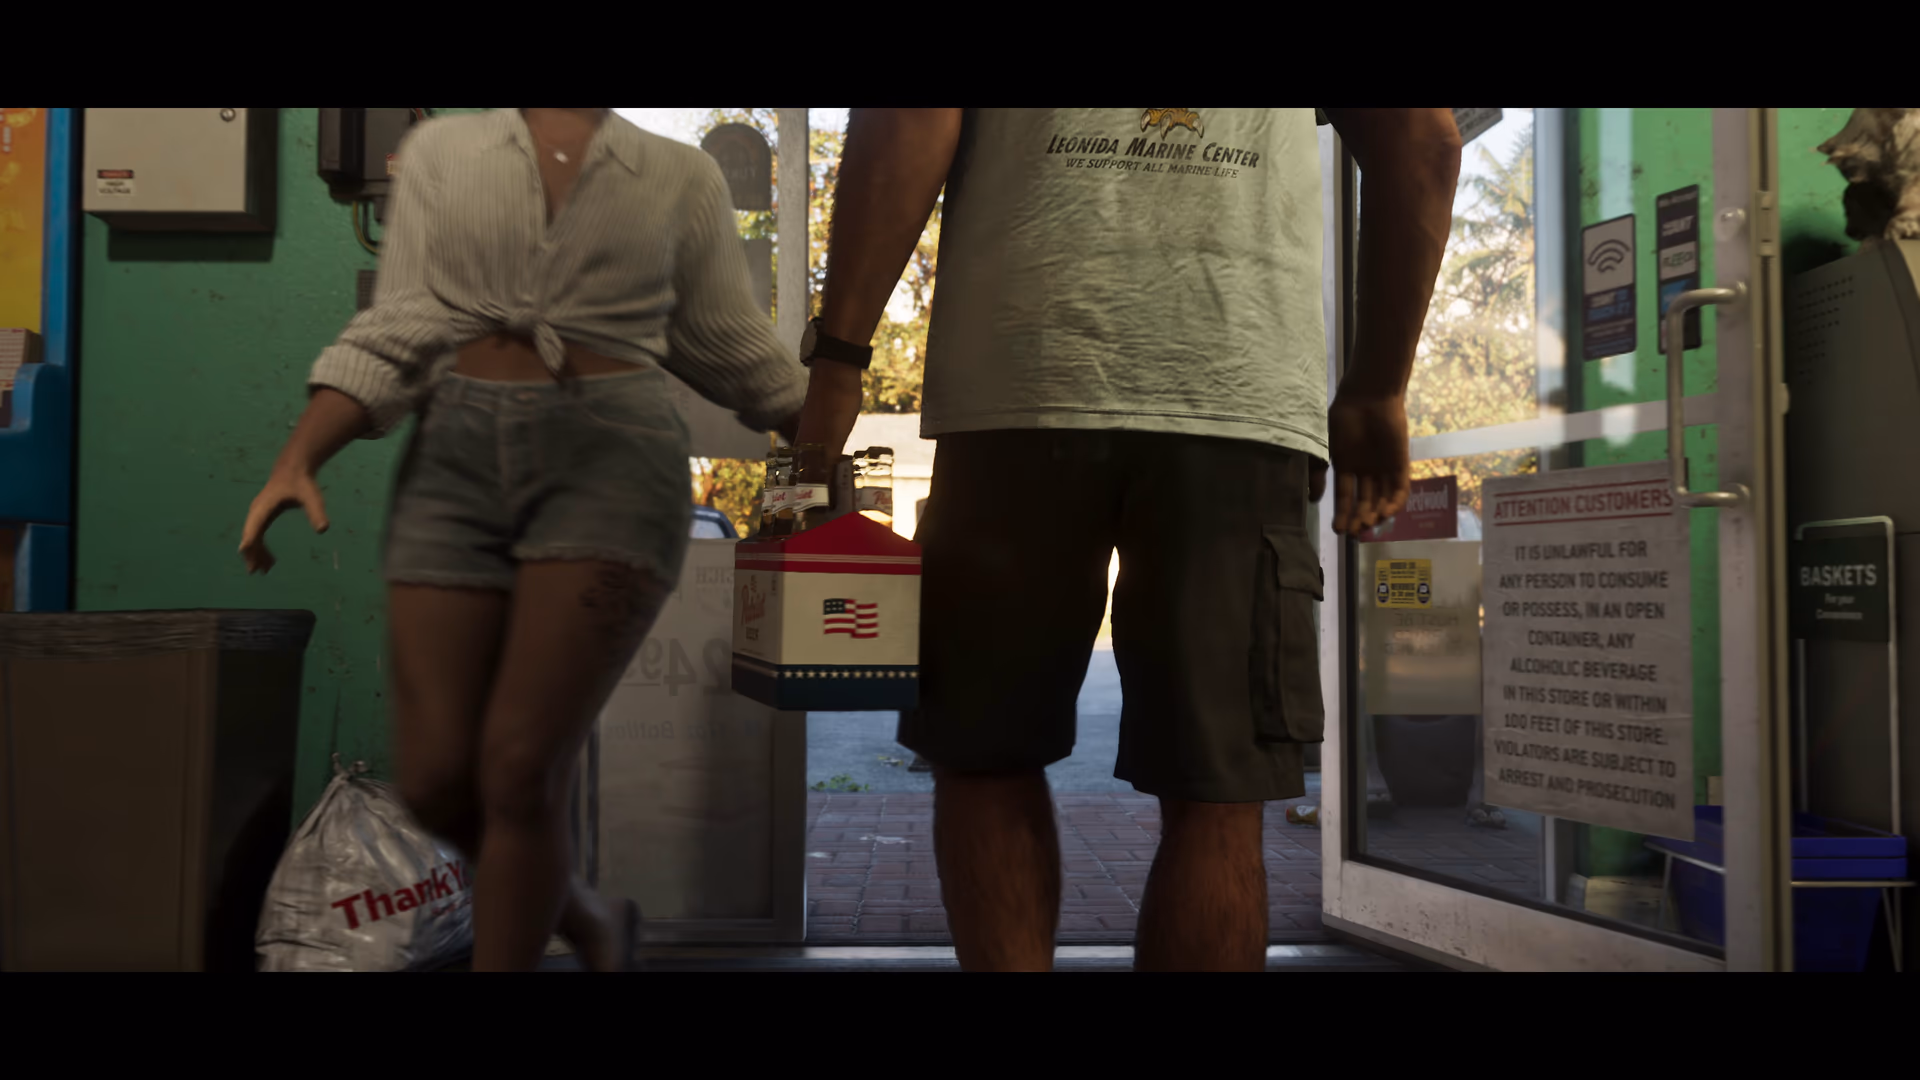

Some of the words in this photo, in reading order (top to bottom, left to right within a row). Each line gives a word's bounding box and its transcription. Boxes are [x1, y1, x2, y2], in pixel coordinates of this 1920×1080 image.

[1046, 134, 1119, 155] LEONIDA
[1125, 137, 1196, 160] MARINE
[1202, 142, 1260, 168] CENTER
[1066, 158, 1083, 168] WE
[1086, 158, 1141, 171] SUPPORT
[1143, 162, 1165, 173] ALL
[1167, 164, 1212, 176] MARINE
[1214, 167, 1239, 179] LIFE
[1493, 494, 1571, 519] ATTENTION
[1574, 488, 1673, 514] CUSTOMERS
[1515, 545, 1527, 561] IT
[1529, 544, 1541, 561] IS
[1543, 542, 1615, 561] UNLAWFUL
[1619, 540, 1647, 558] FOR
[1499, 574, 1522, 590] ANY
[1525, 572, 1575, 589] PERSON
[1580, 572, 1595, 589] TO
[1598, 571, 1669, 589] CONSUME
[1800, 564, 1877, 586] BASKETS
[1503, 601, 1519, 617] OR
[1522, 601, 1583, 620] POSSESS,
[1585, 602, 1599, 618] IN
[1602, 602, 1621, 619] AN
[1626, 602, 1665, 619] OPEN
[1528, 629, 1604, 649] CONTAINER,
[1607, 633, 1635, 648] ANY
[1510, 658, 1580, 677] ALCOHOLIC
[1583, 661, 1657, 682] BEVERAGE
[1503, 685, 1516, 701] IN
[1518, 686, 1546, 703] THIS
[1548, 688, 1589, 707] STORE
[1593, 691, 1612, 708] OR
[1615, 693, 1667, 713] WITHIN
[1505, 713, 1527, 729] 100
[1530, 715, 1561, 732] FEET
[1564, 718, 1580, 735] OF
[1584, 720, 1614, 740] THIS
[1494, 739, 1560, 762] VIOLATORS
[1563, 748, 1588, 766] ARE
[1591, 751, 1653, 775] SUBJECT
[1658, 760, 1676, 778] TO
[1499, 768, 1544, 787] ARREST
[1547, 775, 1574, 794] AND
[1577, 778, 1675, 809] PROSECUTION
[331, 868, 454, 930] Thank
[445, 860, 473, 891] Yo
